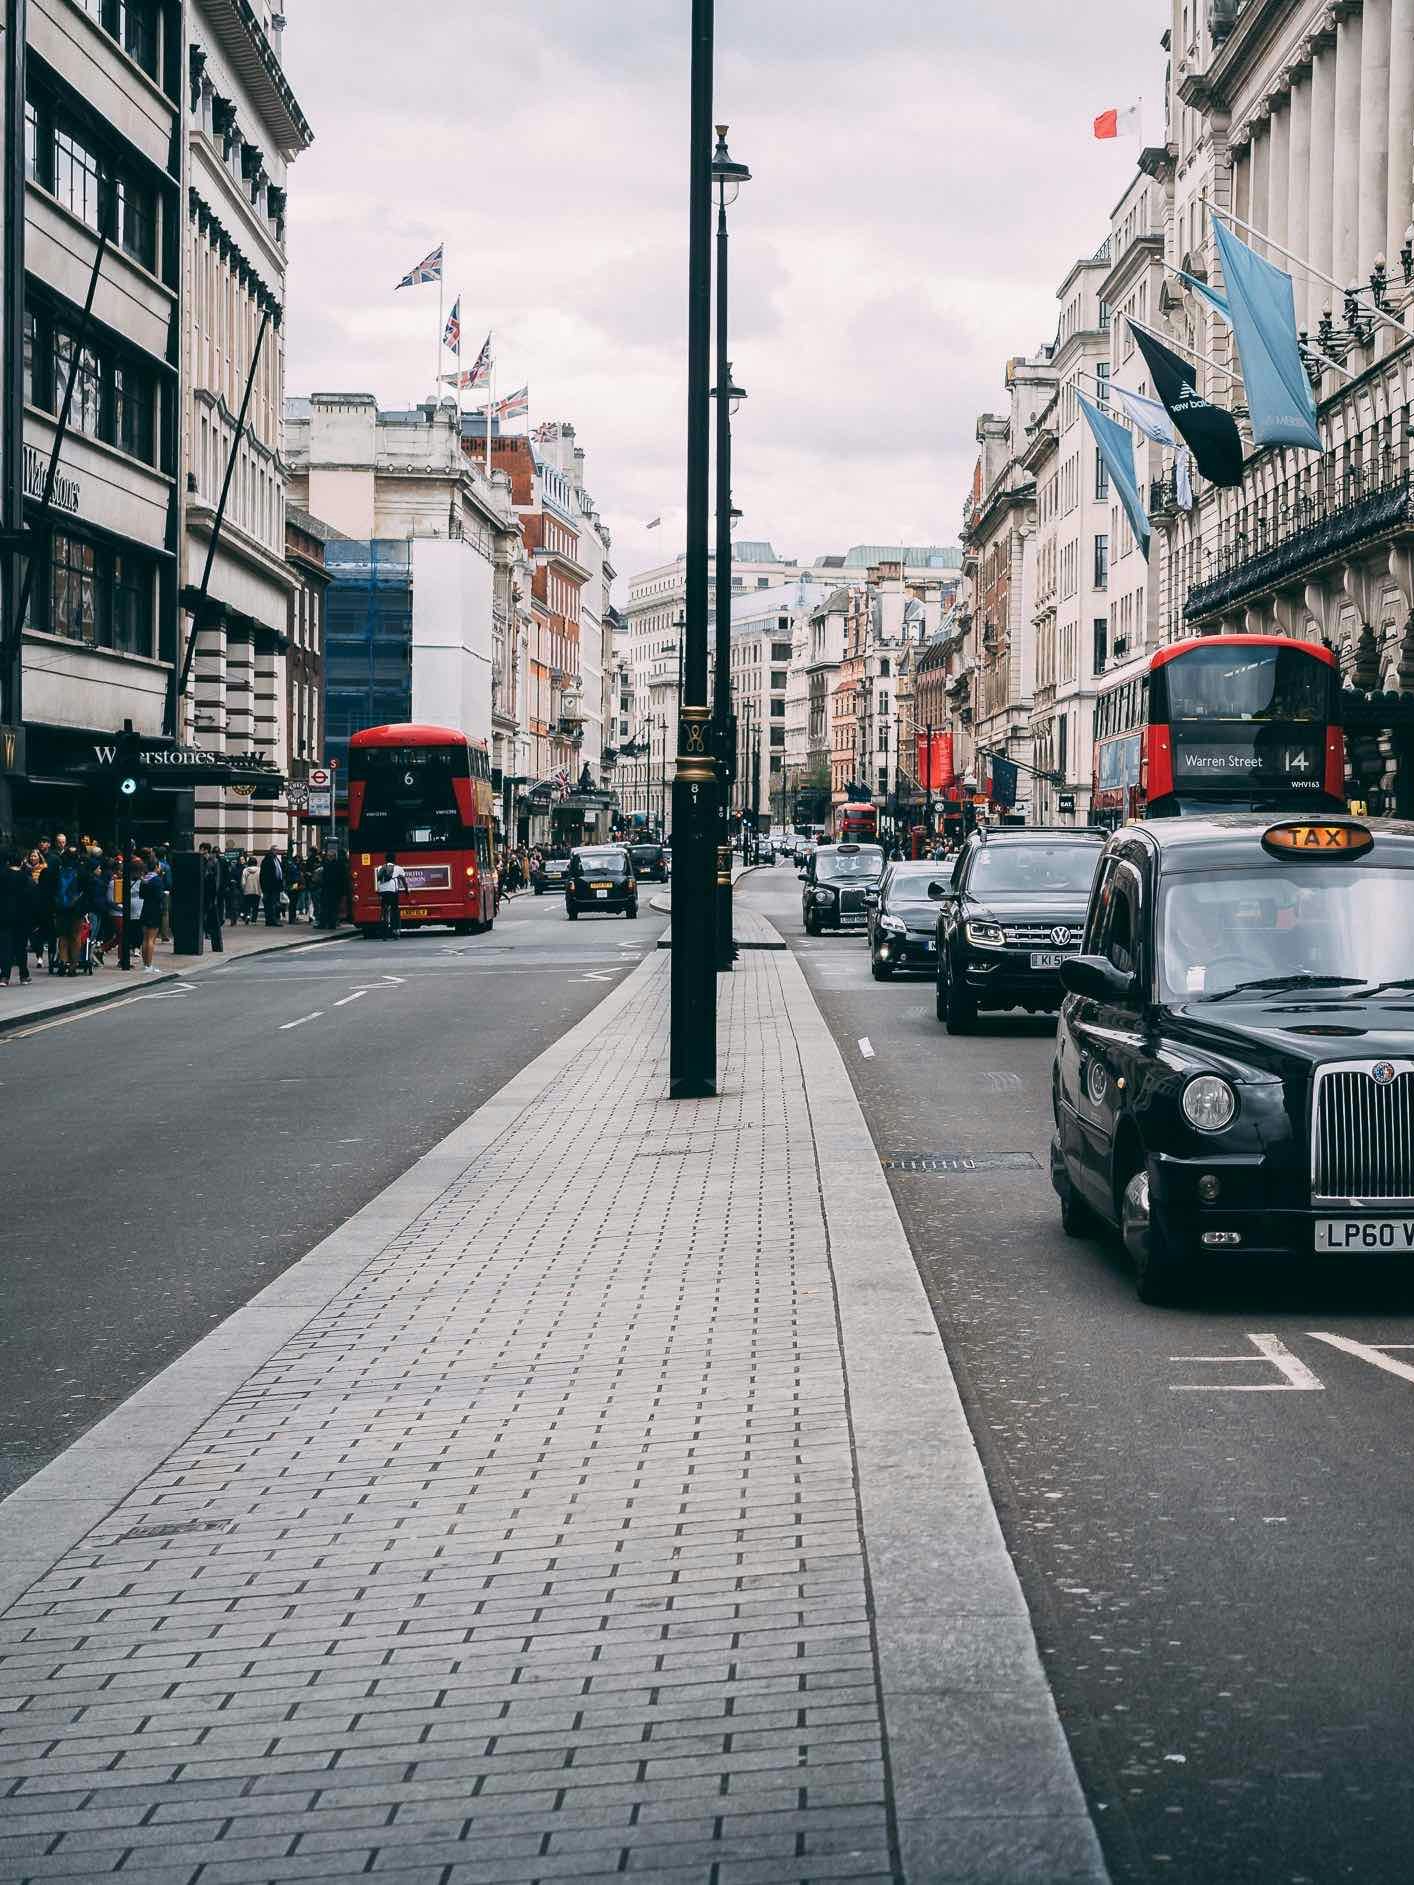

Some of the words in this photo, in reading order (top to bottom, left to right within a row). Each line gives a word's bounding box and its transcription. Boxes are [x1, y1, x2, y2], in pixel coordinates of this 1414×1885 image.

[1185, 754, 1226, 767] Warren
[1228, 754, 1264, 768] Street
[1285, 750, 1310, 772] 14
[404, 772, 414, 785] 6
[1287, 828, 1353, 847] TAXI
[1327, 1222, 1395, 1248] LP60
